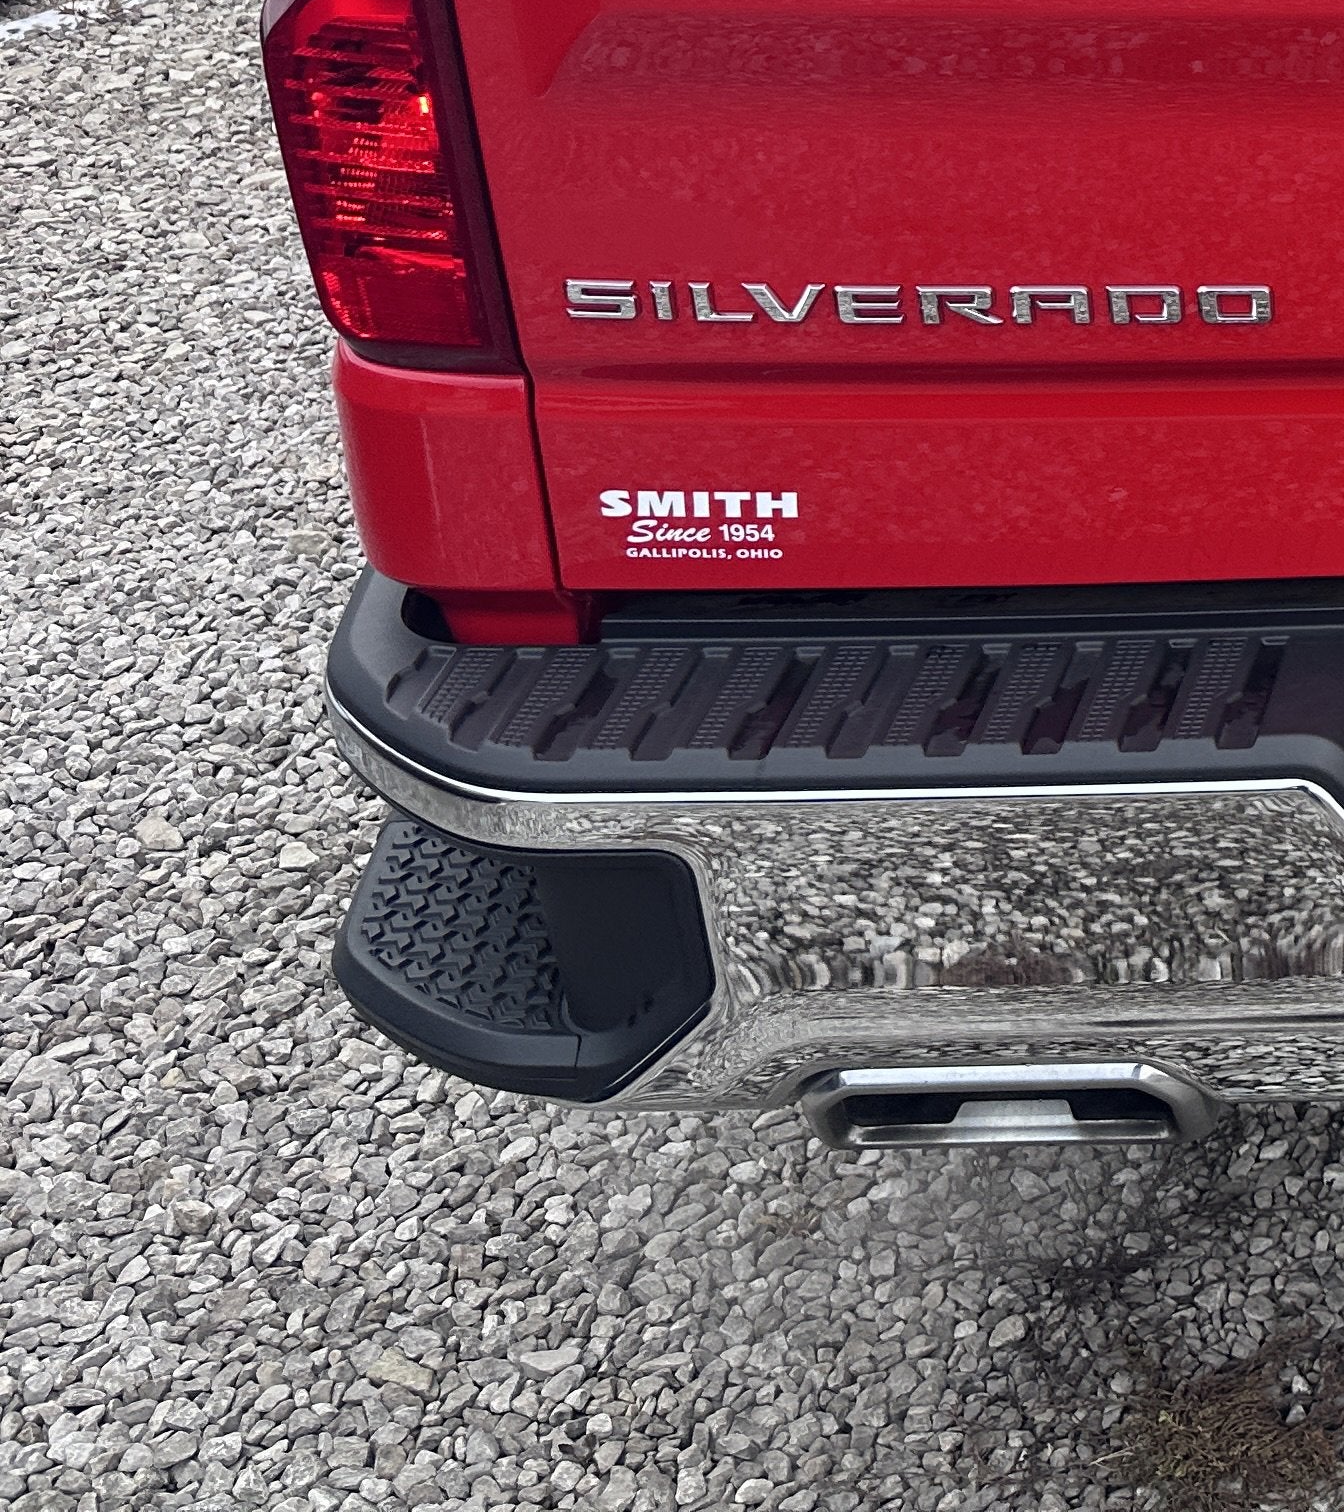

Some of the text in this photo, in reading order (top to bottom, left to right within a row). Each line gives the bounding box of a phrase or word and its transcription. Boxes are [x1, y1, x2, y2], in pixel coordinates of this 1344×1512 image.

[565, 278, 1272, 325] SILVERADO
[600, 489, 799, 519] SMITH
[626, 519, 775, 543] Since 1954
[625, 547, 784, 560] GALLIPOLIS, OHIO
